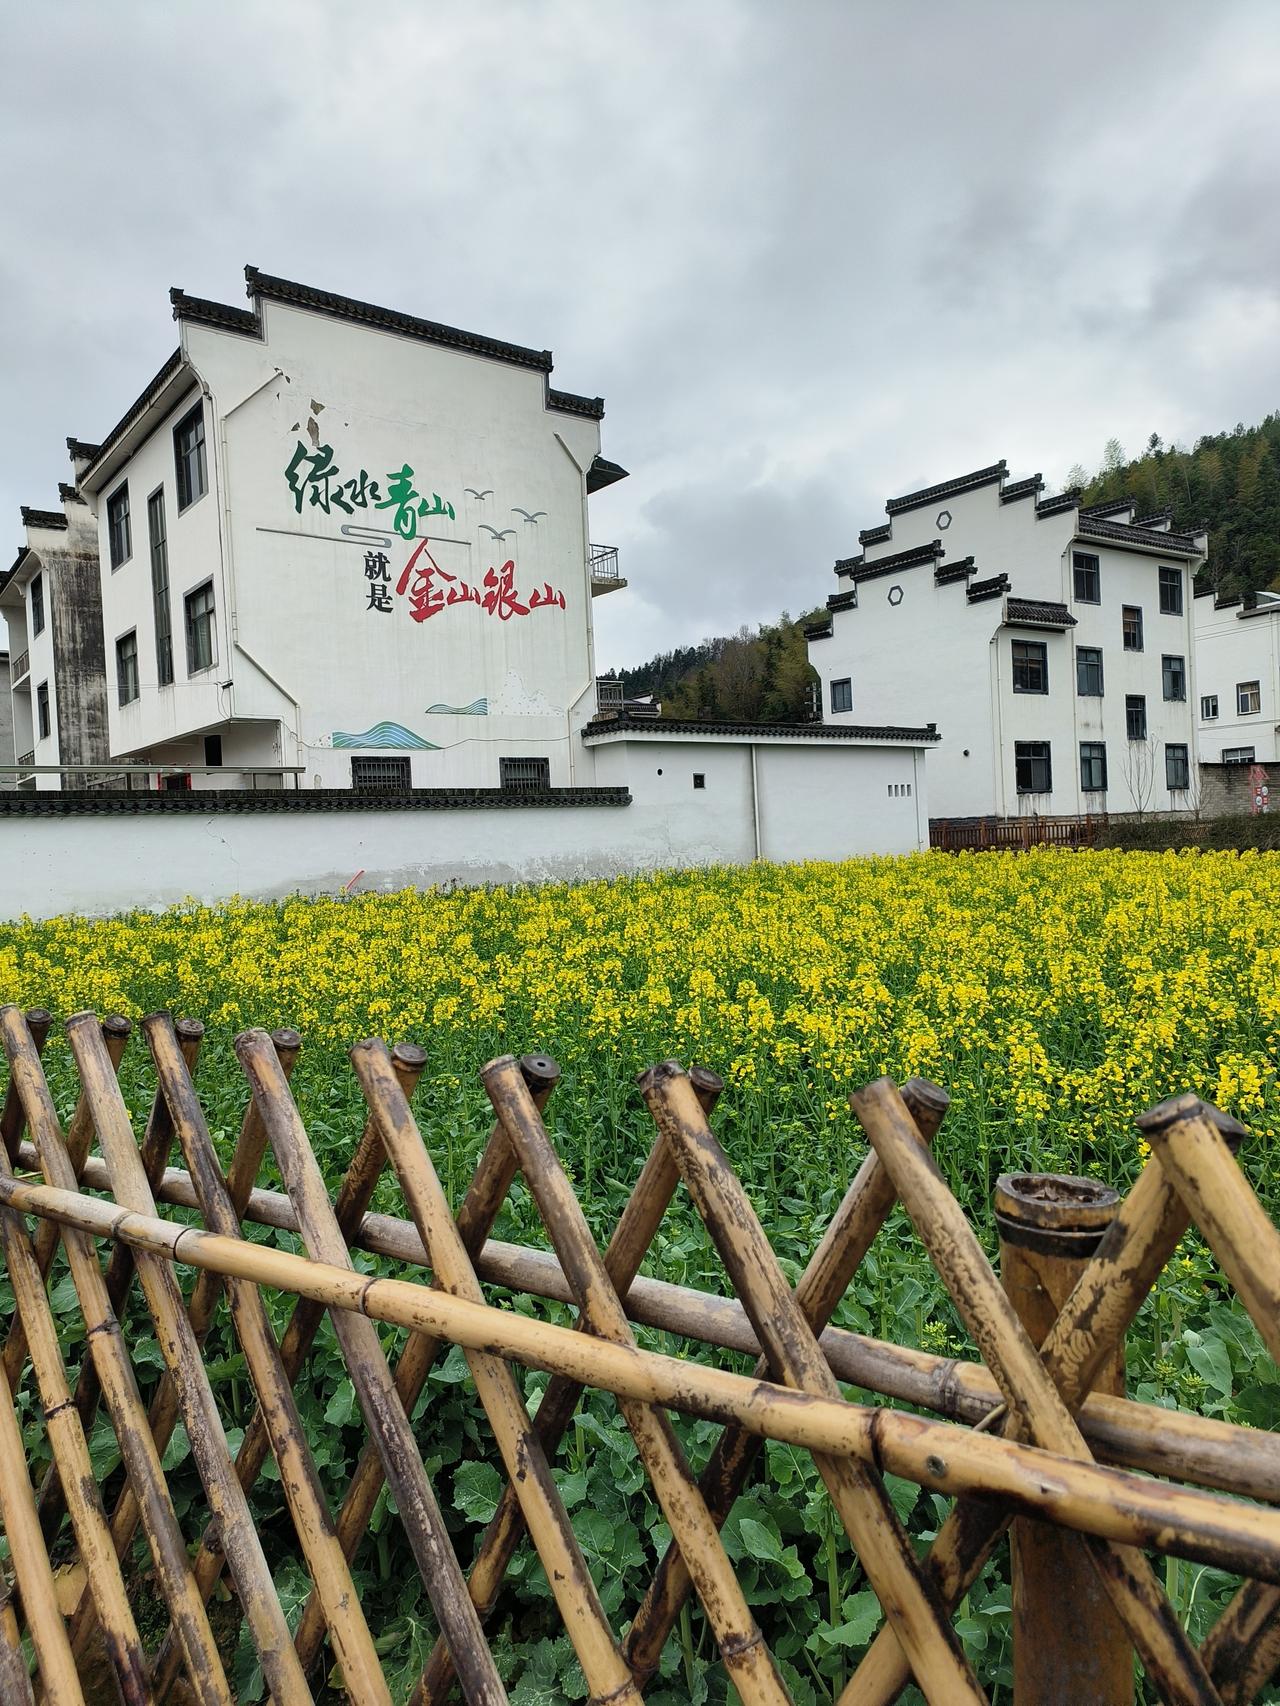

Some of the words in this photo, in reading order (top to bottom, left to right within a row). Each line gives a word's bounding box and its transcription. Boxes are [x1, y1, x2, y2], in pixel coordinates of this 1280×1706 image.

[285, 440, 455, 540] 绿水青山
[363, 551, 393, 613] 就是
[396, 538, 566, 623] 金山银山
